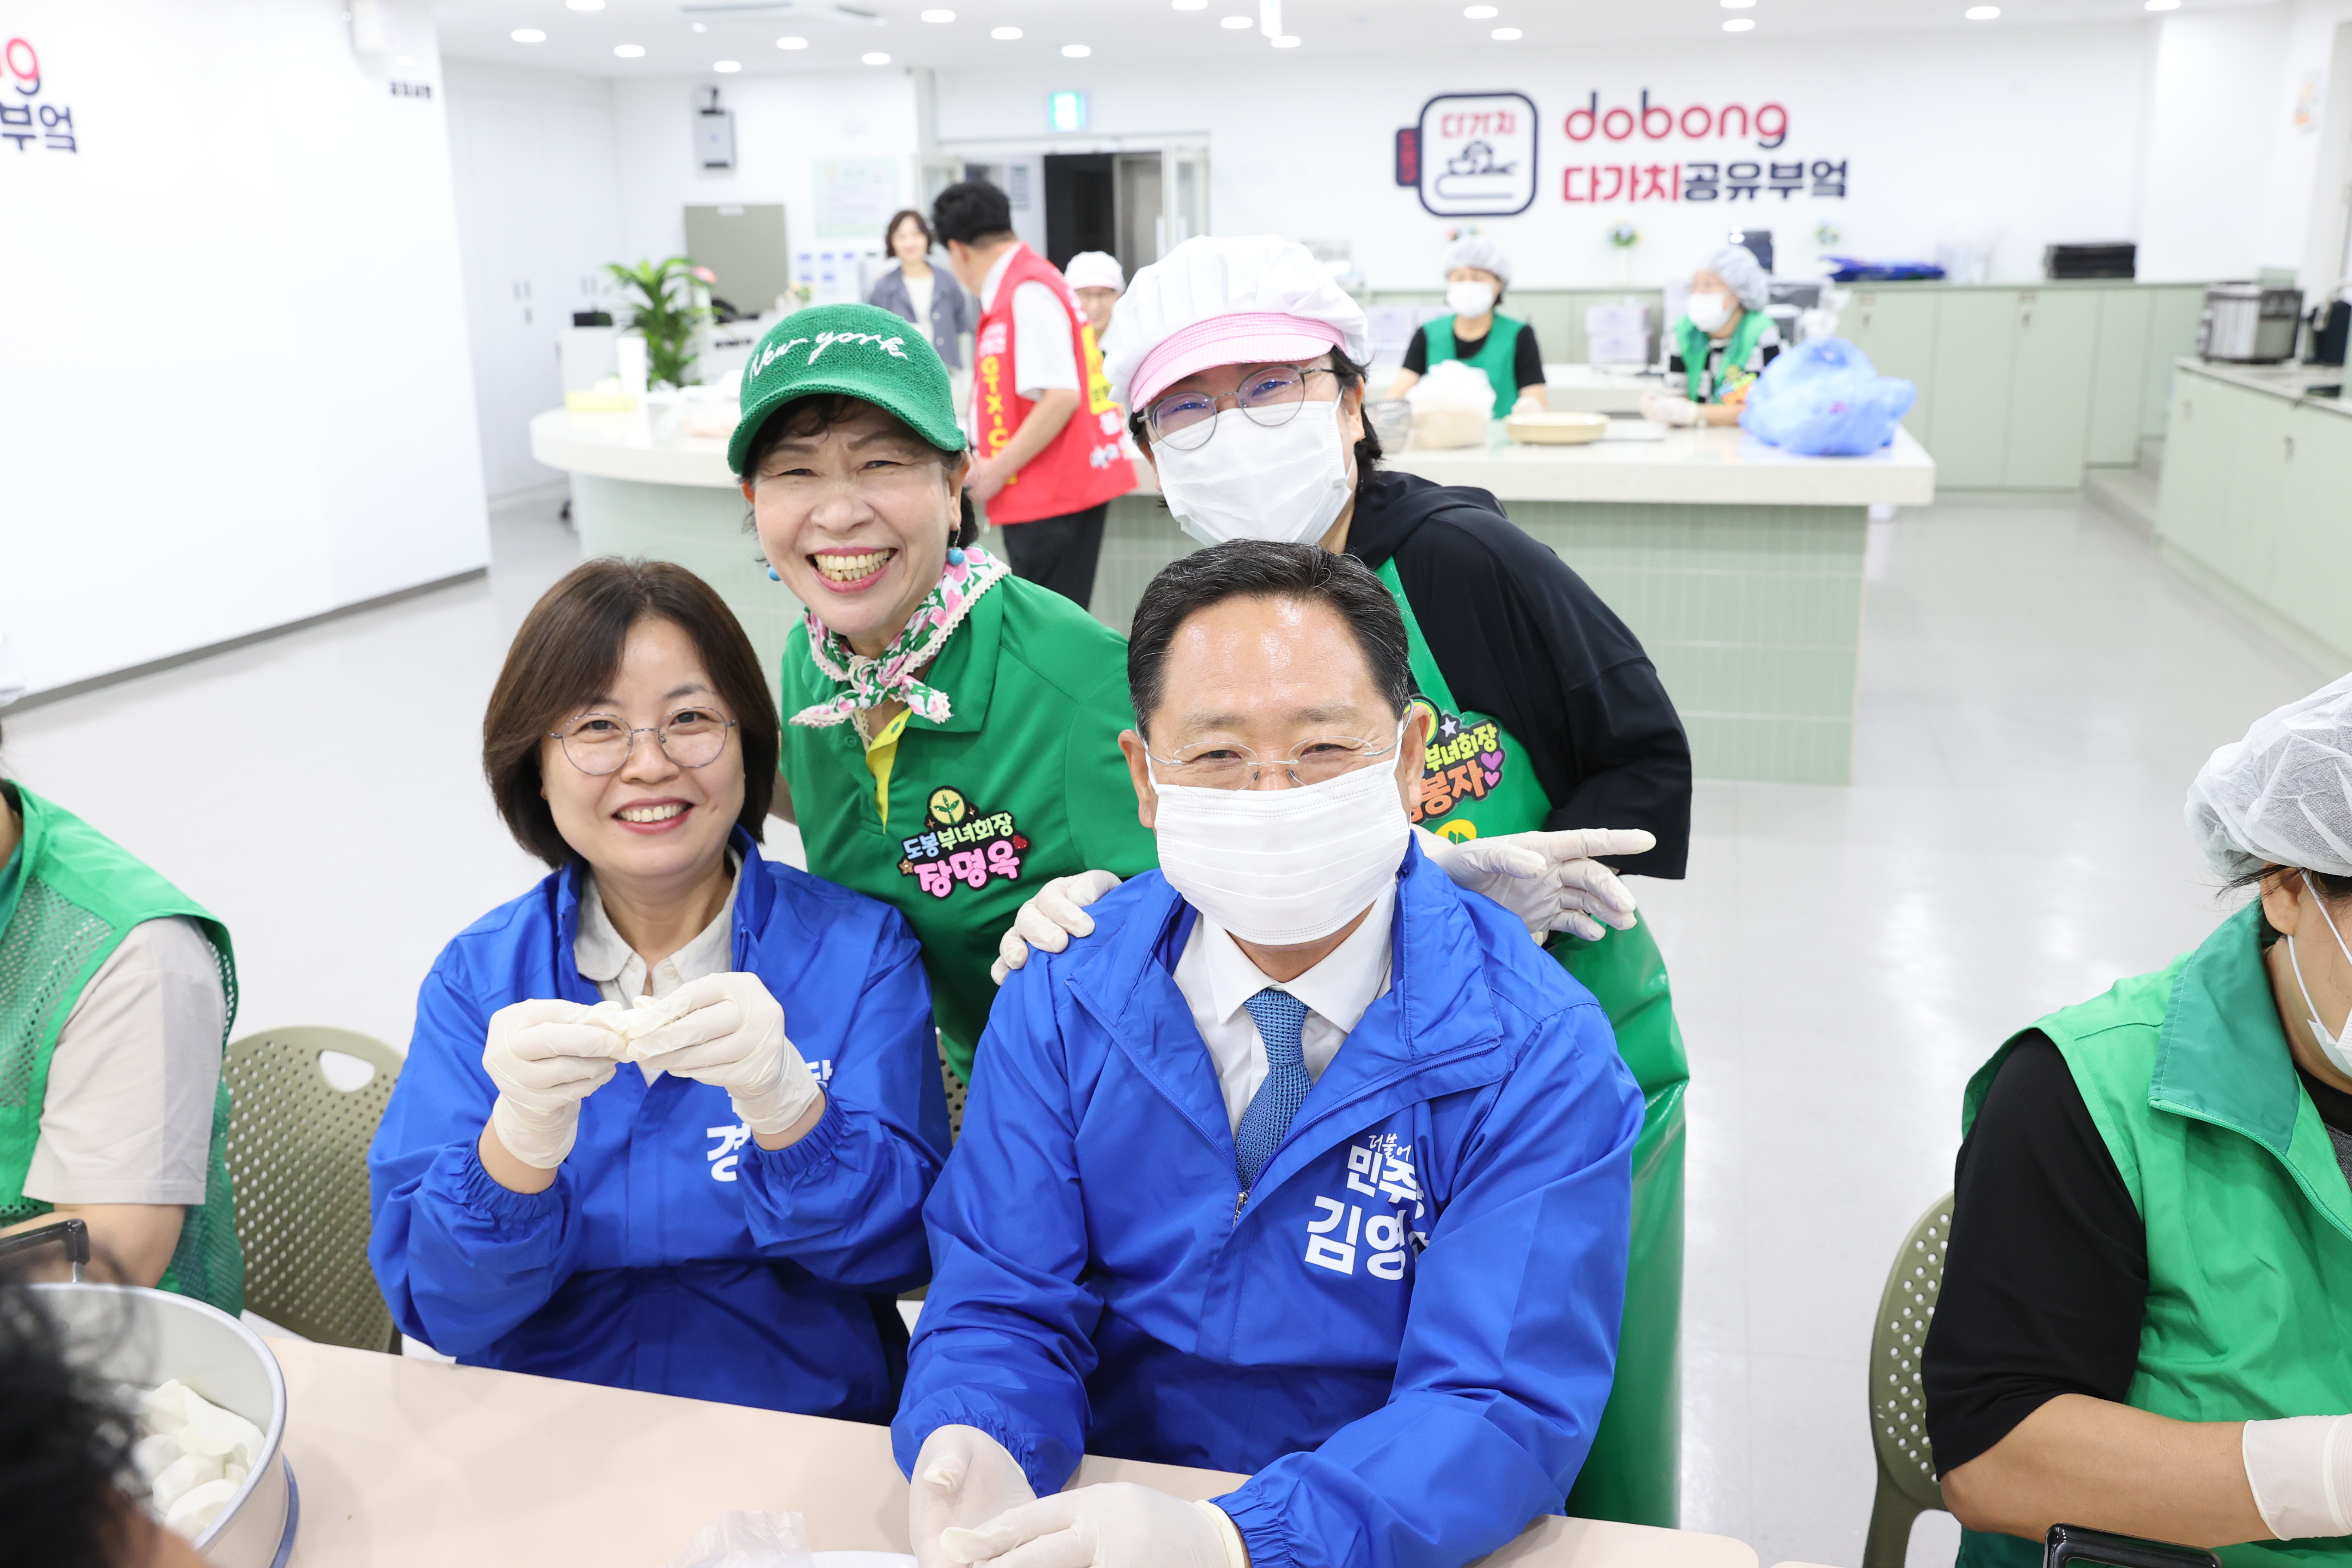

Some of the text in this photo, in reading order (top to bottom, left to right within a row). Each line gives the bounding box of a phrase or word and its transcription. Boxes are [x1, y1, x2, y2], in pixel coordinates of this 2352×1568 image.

[0, 39, 40, 95] g
[1442, 112, 1515, 138] 다가치
[1565, 89, 1787, 149] dobong
[1562, 160, 1847, 202] 다가치공유부엌
[749, 342, 809, 385] New
[1422, 723, 1498, 777] 부녀회장
[1411, 759, 1485, 823] 봉자
[1368, 1133, 1412, 1162] 더불어
[1304, 1195, 1430, 1281] 김영
